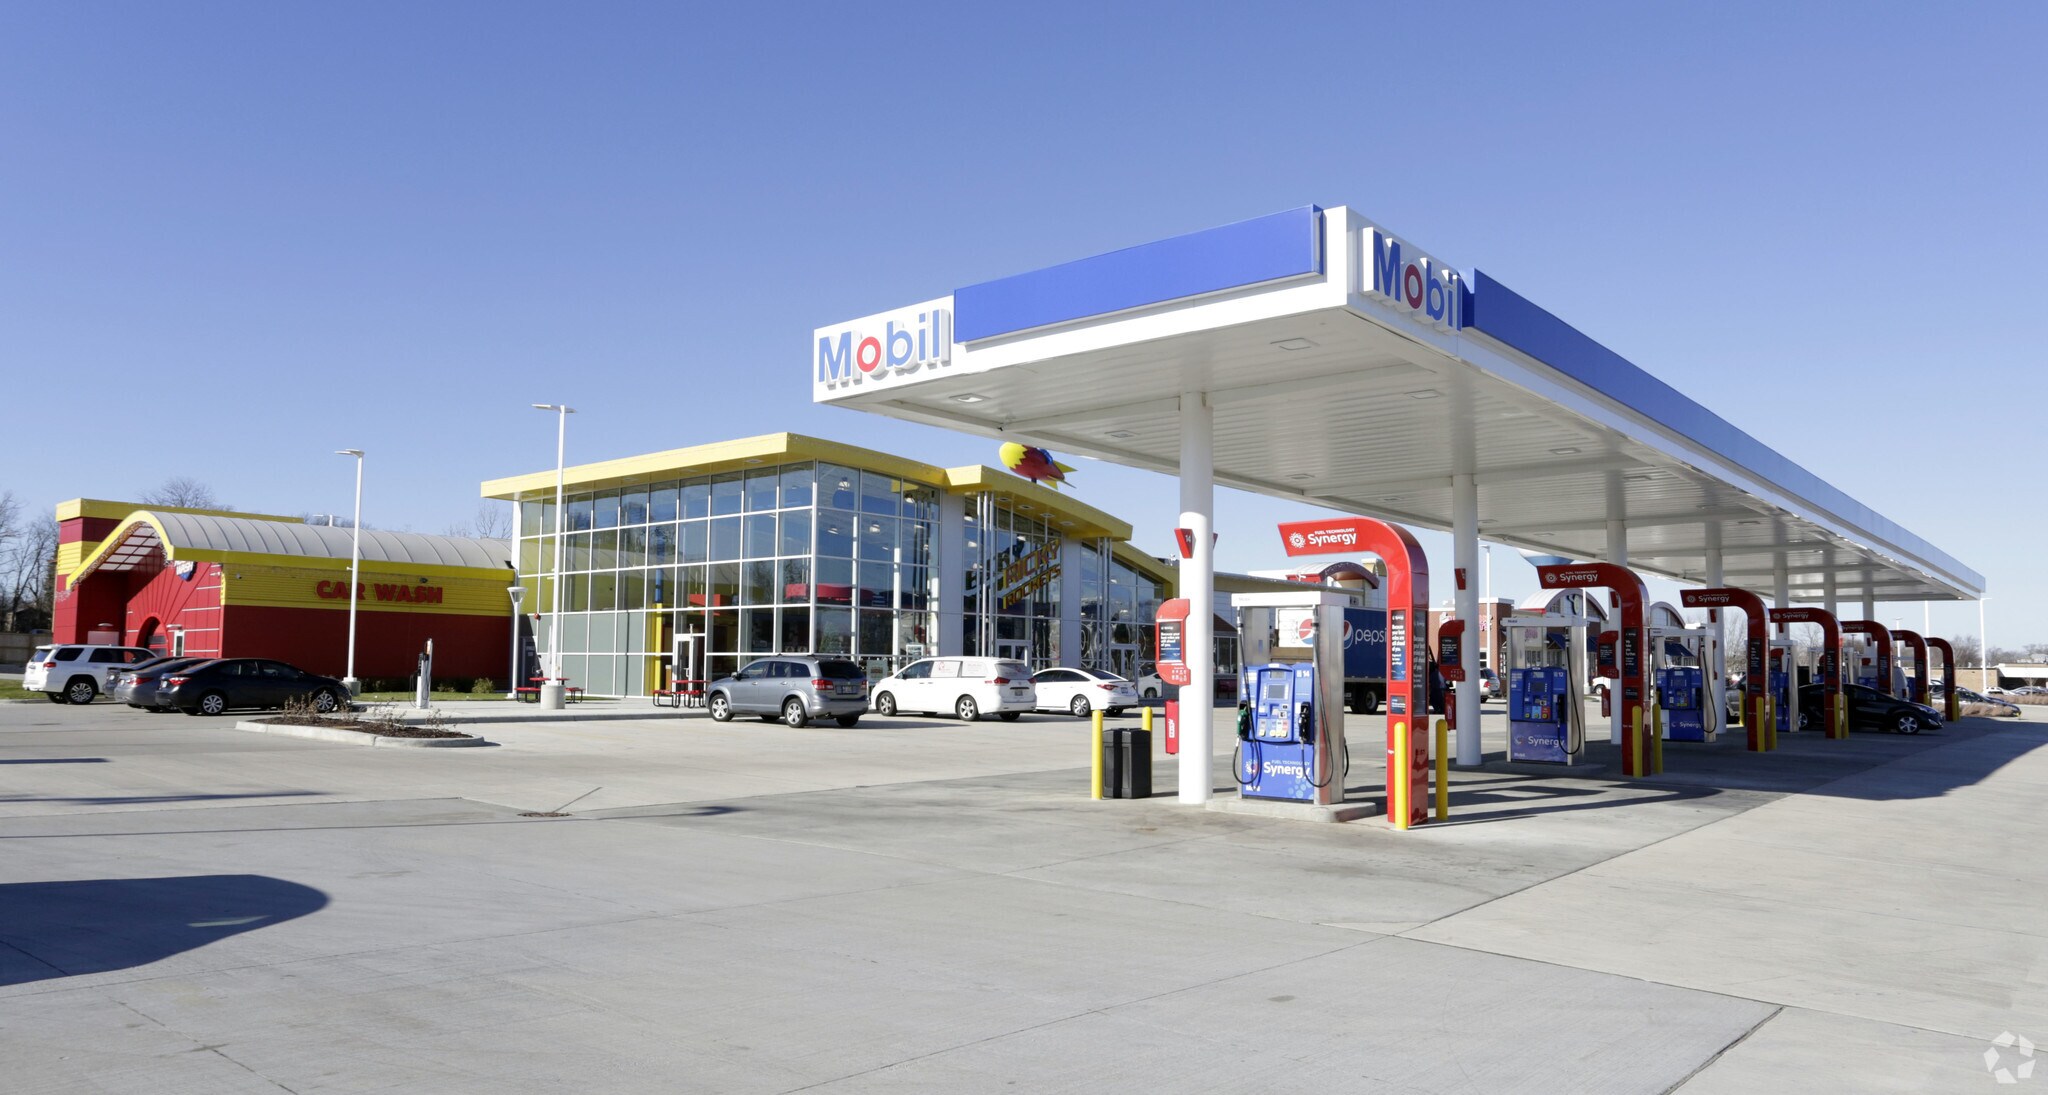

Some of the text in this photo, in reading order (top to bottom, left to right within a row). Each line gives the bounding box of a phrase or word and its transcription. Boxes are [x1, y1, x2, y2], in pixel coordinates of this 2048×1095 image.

[1373, 229, 1462, 332] Mobil
[818, 309, 940, 383] Mobil
[1307, 533, 1357, 547] Synergy
[1003, 538, 1060, 590] RICKY
[1003, 563, 1060, 610] ROCKETS
[1560, 573, 1598, 583] Synergy
[316, 580, 443, 604] CAR WASH
[1698, 595, 1730, 603] Synergy
[1355, 628, 1386, 645] pepsi
[1528, 736, 1564, 748] Synergy
[1264, 762, 1310, 779] Synergy
